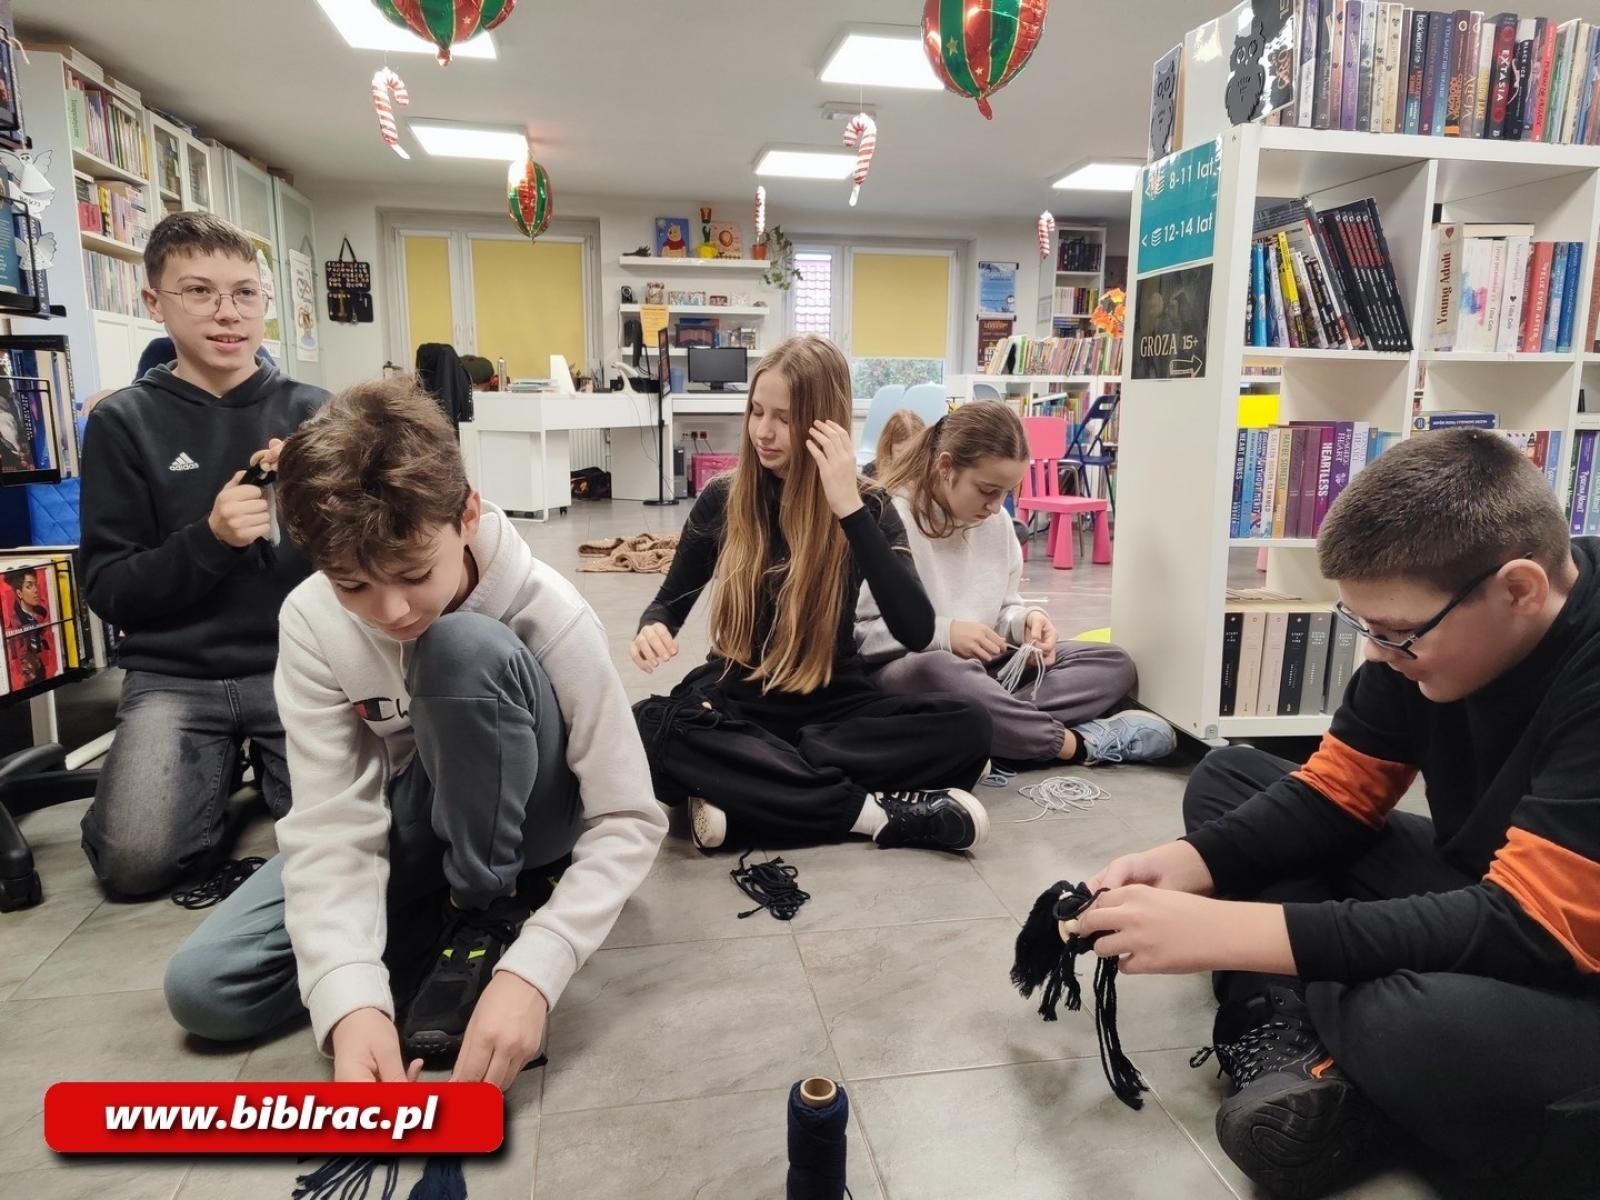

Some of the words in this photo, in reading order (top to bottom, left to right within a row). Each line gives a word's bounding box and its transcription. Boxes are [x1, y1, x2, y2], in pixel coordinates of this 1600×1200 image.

[1521, 41, 1529, 64] BLACK
[1496, 49, 1510, 102] EXTASIA
[1169, 166, 1193, 189] 8-11
[1164, 217, 1193, 243] 12-14
[1197, 212, 1213, 232] lat
[1440, 252, 1451, 284] Adult
[1436, 287, 1452, 325] Young
[1140, 333, 1178, 358] GROZA
[1182, 334, 1199, 351] 15+
[1281, 434, 1291, 457] MAYBE
[1335, 432, 1345, 463] HEART
[1254, 460, 1264, 490] WITHOUT
[1318, 442, 1333, 497] HEARTLESS
